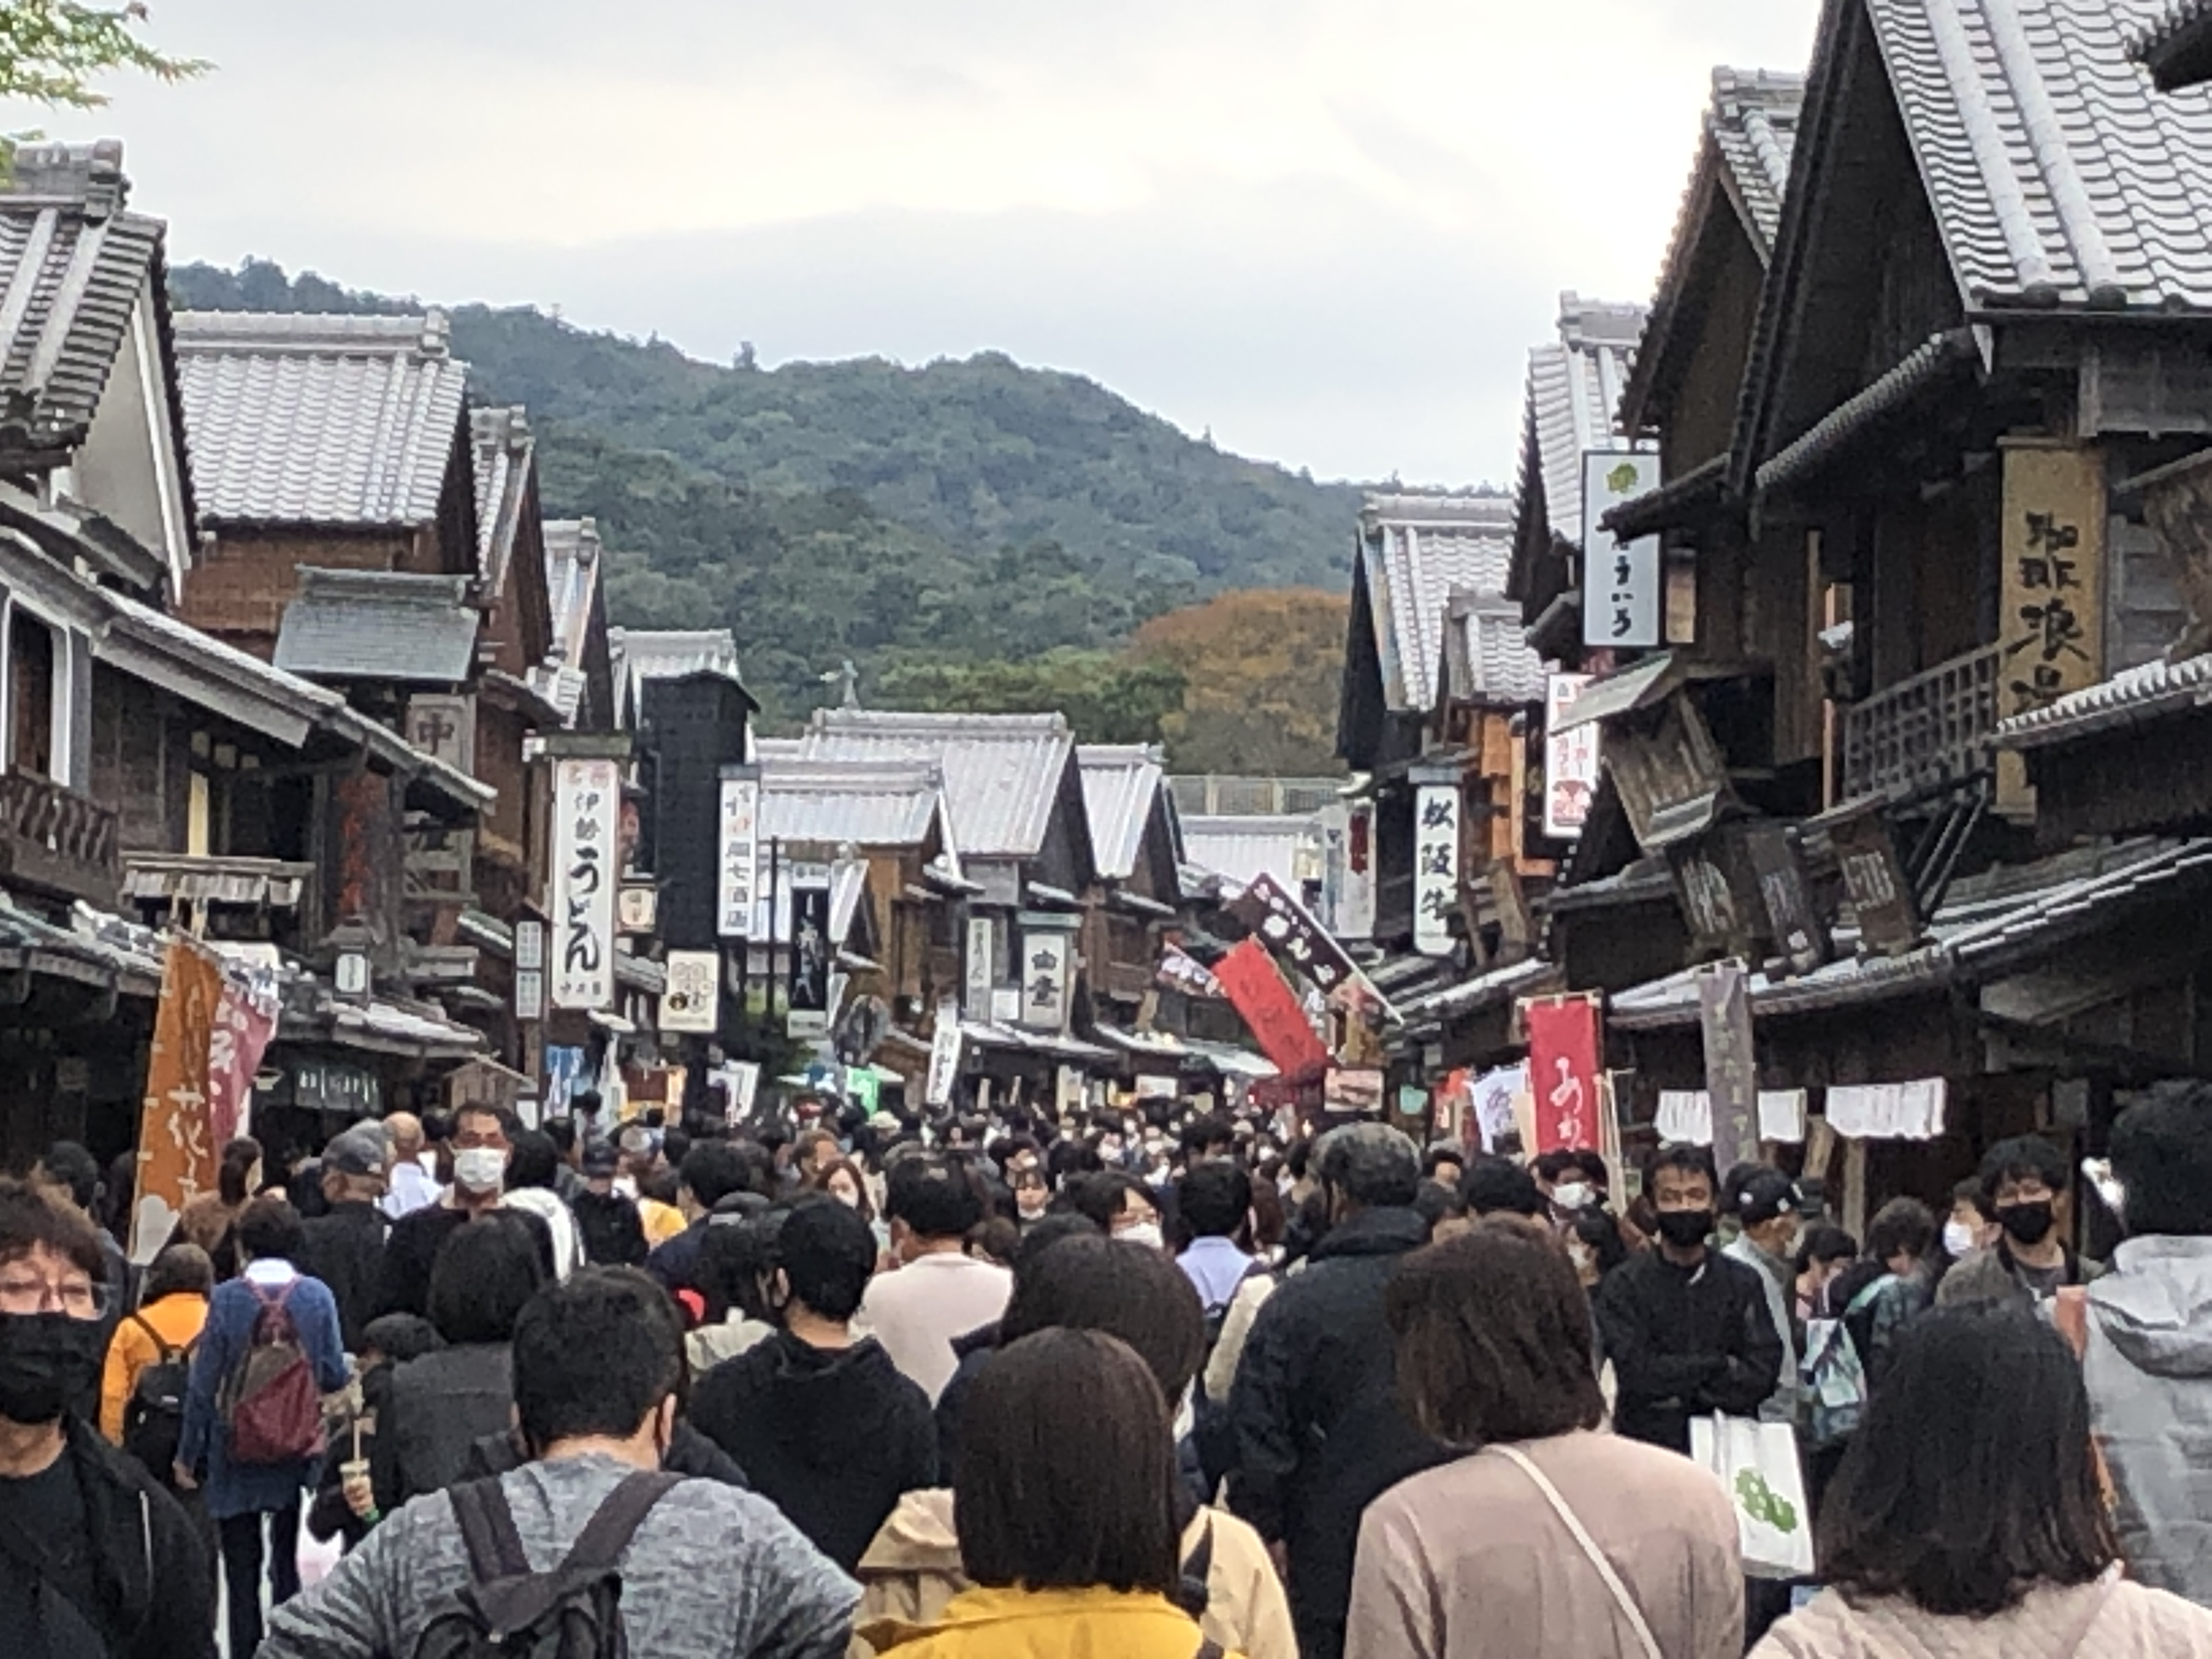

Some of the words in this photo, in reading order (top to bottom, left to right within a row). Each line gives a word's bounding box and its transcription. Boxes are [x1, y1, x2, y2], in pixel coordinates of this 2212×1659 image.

[1611, 541, 1634, 637] ういろ
[565, 792, 601, 974] 伊勢うどん
[1420, 797, 1455, 921] 松阪牛
